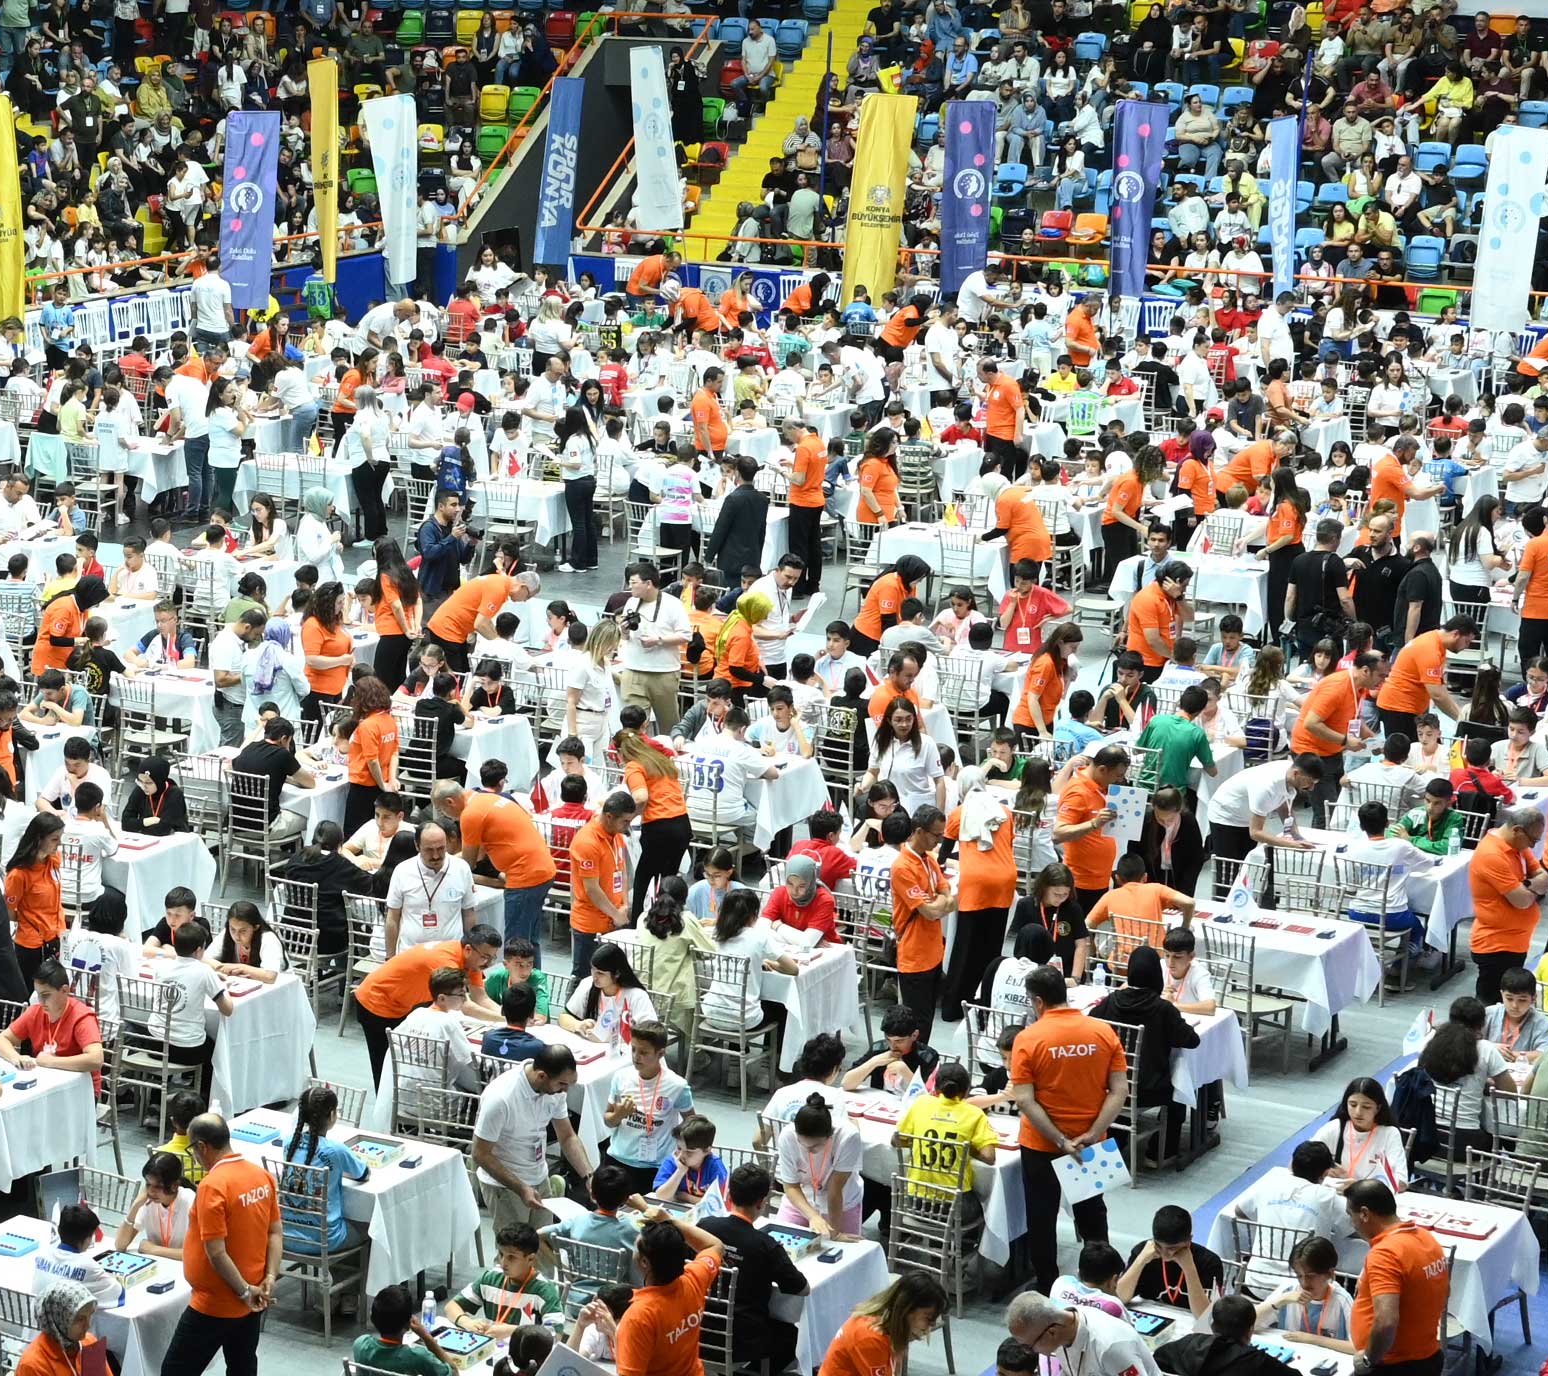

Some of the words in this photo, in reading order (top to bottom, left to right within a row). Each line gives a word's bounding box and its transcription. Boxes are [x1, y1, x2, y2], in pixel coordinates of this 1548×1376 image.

[540, 133, 566, 228] KONYA
[559, 132, 577, 209] SPOR
[1048, 1043, 1097, 1060] TAZOF
[238, 1184, 270, 1207] TAZOF
